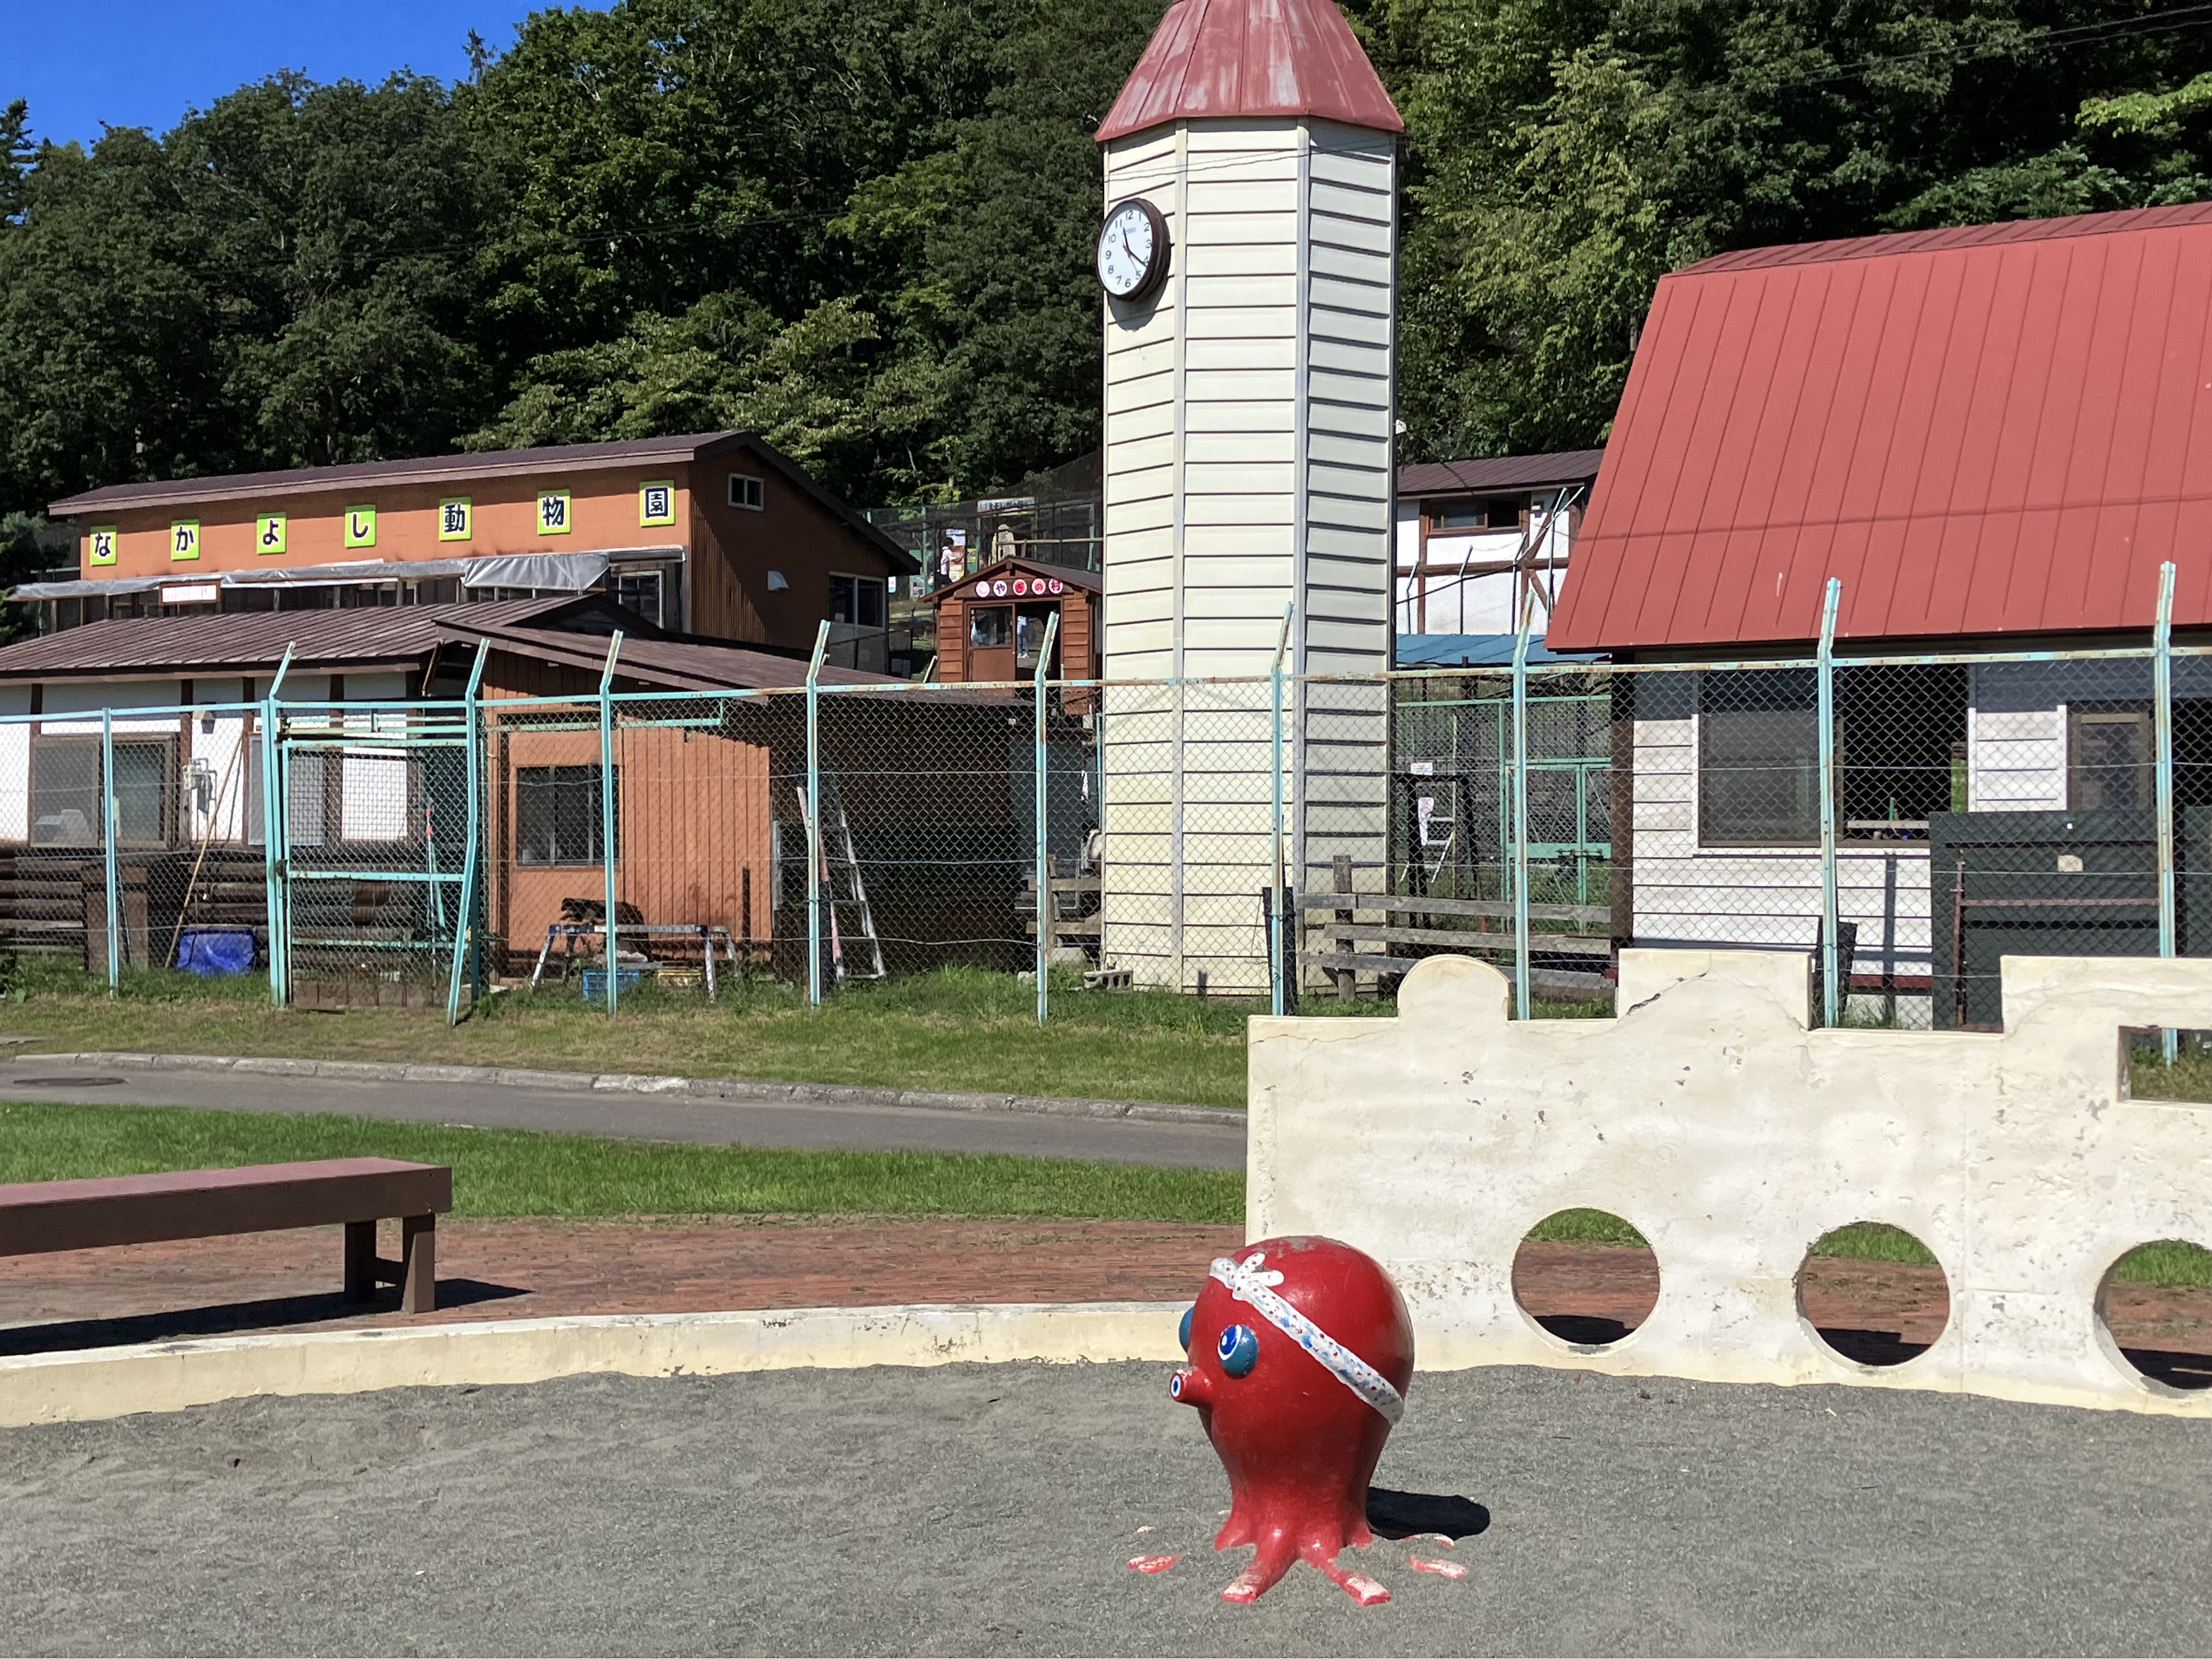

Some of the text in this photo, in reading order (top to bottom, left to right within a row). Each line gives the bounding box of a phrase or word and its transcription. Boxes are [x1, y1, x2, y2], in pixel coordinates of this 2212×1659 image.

[1126, 210, 1134, 221] 12
[1138, 213, 1142, 222] 1
[1115, 219, 1122, 229] 11
[1144, 222, 1150, 232] 2
[1108, 233, 1116, 244] 10
[1145, 239, 1152, 249] 3
[1105, 250, 1111, 260] 9
[1108, 264, 1114, 274] 8
[1115, 275, 1122, 285] 7
[1135, 270, 1142, 280] 5
[1125, 278, 1131, 288] 6
[94, 486, 668, 557] なかよし動物園
